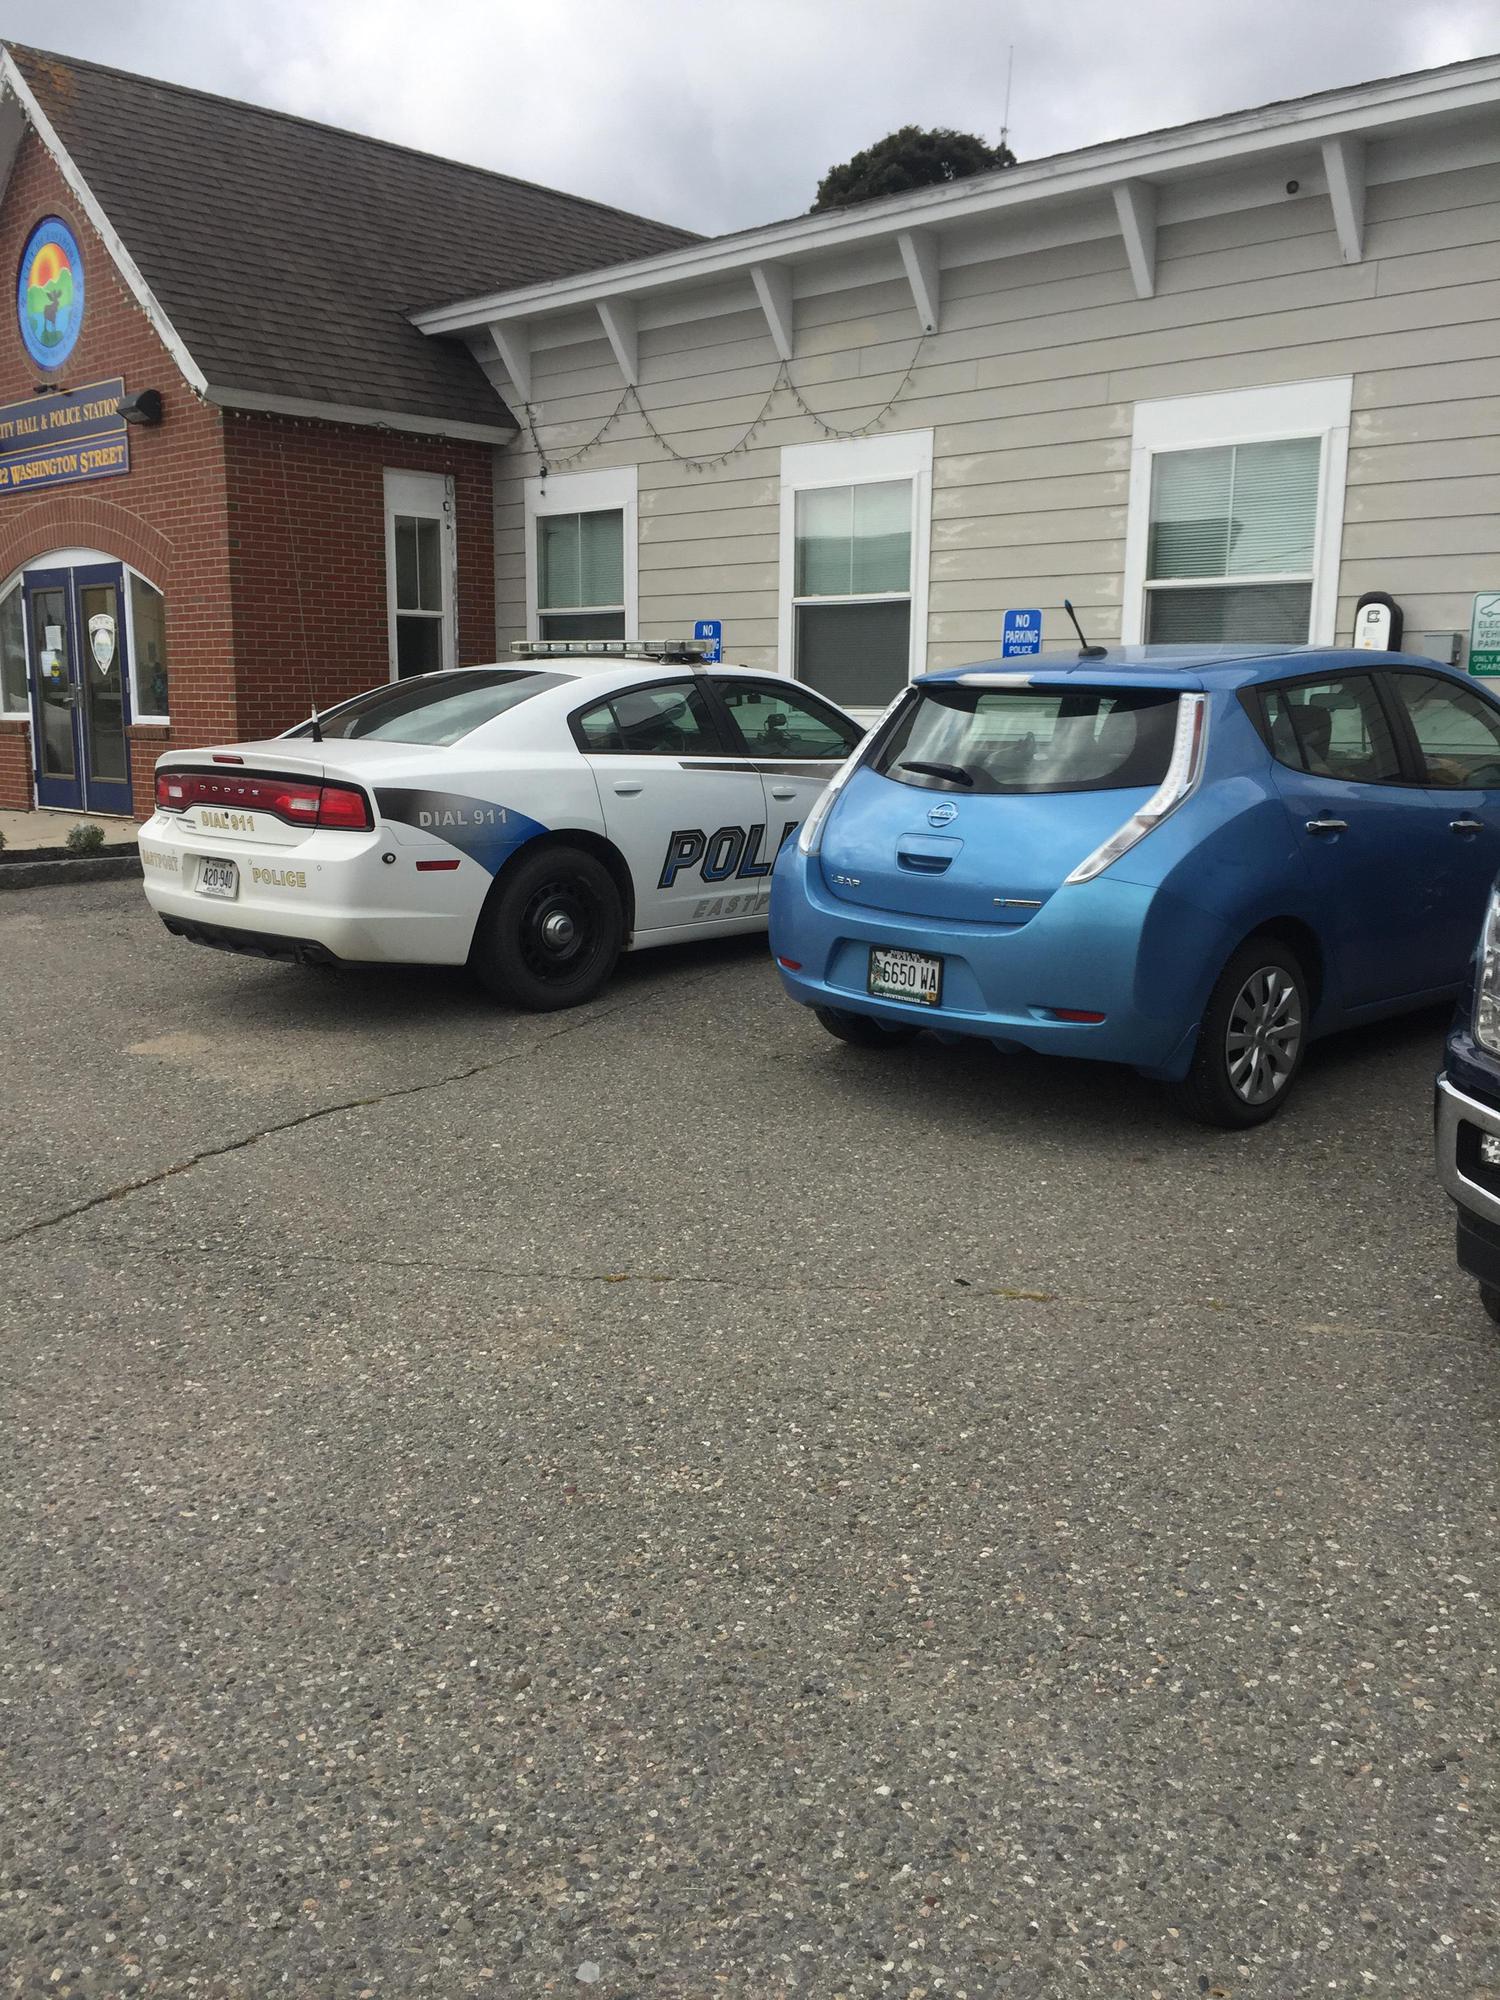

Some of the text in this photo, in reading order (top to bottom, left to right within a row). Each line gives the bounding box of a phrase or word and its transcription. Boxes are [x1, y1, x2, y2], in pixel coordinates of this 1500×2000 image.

[16, 416, 39, 434] HALL
[40, 414, 48, 430] &
[50, 406, 81, 428] POLICE
[83, 397, 120, 420] STATION
[10, 454, 77, 485] WASHINGTON
[79, 445, 124, 473] STREET
[702, 624, 713, 636] NO
[1015, 614, 1030, 628] NO
[1005, 629, 1039, 644] PARKING
[1009, 645, 1033, 654] POLICE
[1472, 655, 1495, 663] ONLY
[201, 810, 229, 830] DIAL
[230, 814, 255, 832] 911
[419, 803, 507, 827] DIAL 911
[252, 867, 307, 888] POLICE
[890, 949, 922, 964] MAINE
[883, 960, 937, 992] 6650 WA
